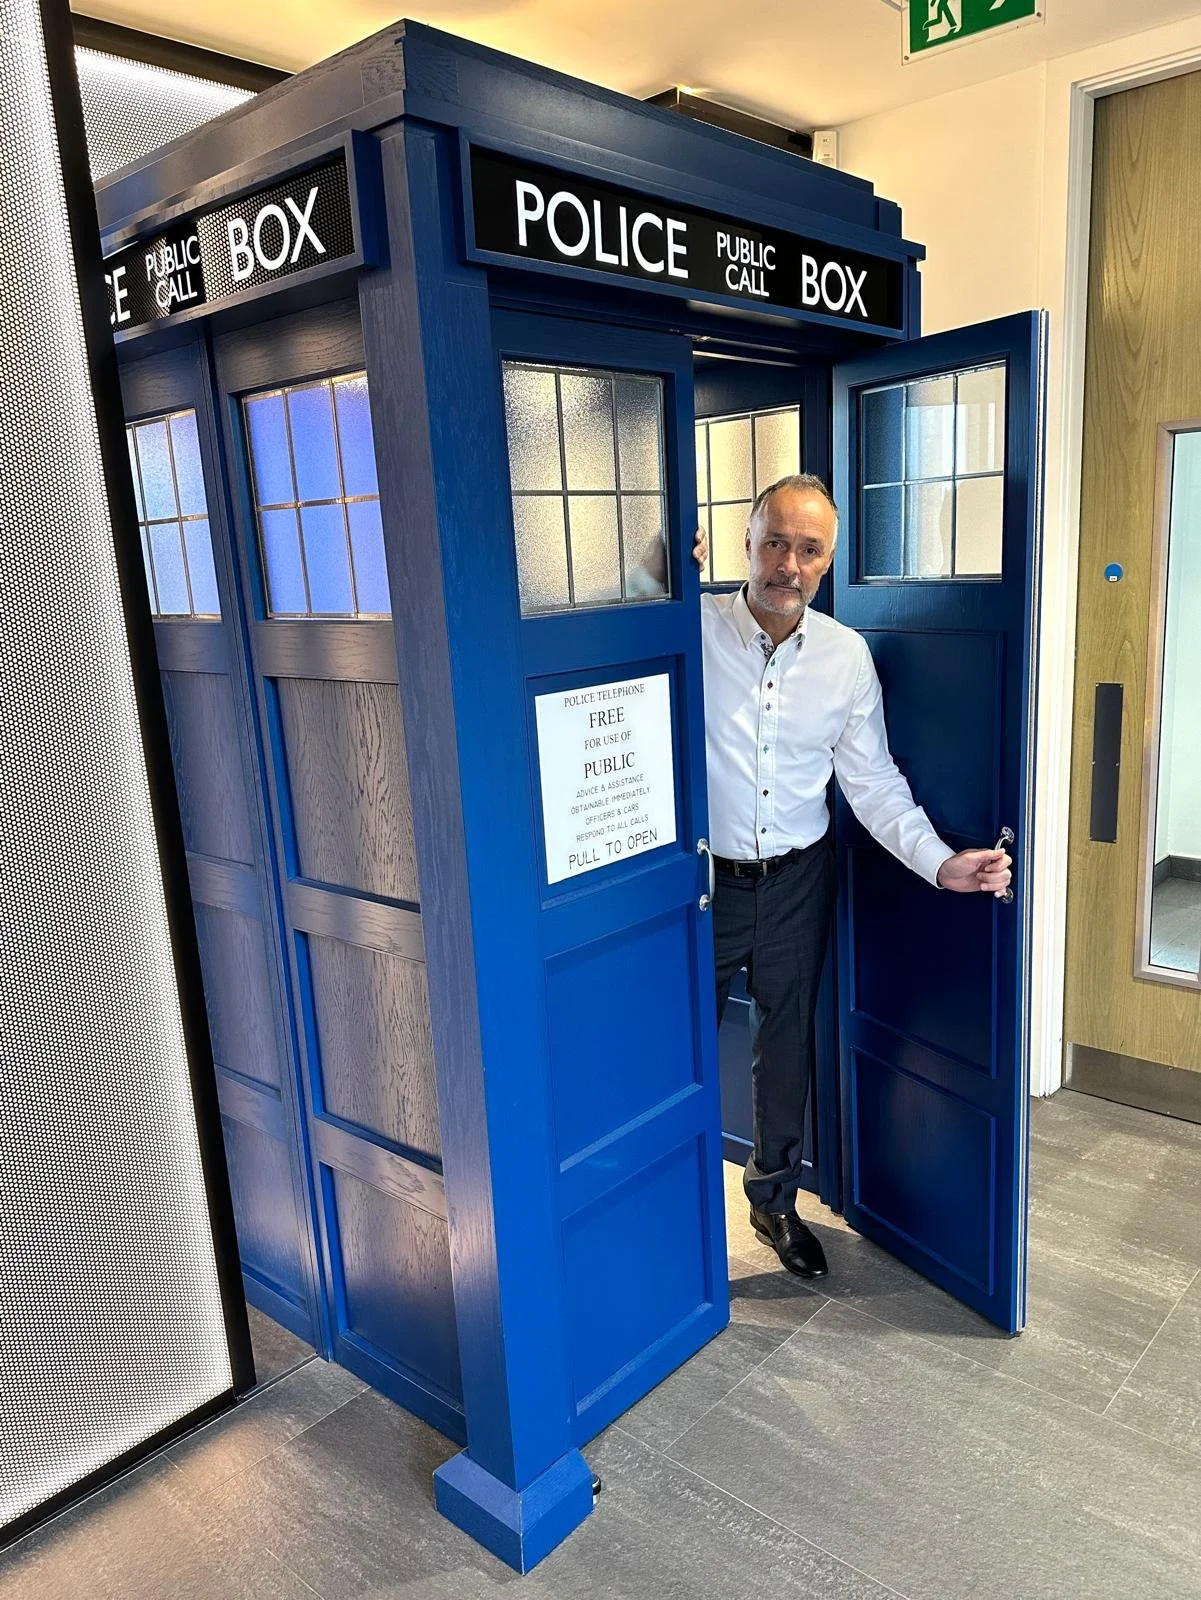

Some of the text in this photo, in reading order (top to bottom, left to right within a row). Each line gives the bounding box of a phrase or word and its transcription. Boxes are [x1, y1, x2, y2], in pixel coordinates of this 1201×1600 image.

[227, 187, 326, 282] BOX
[516, 180, 688, 278] POLICE
[146, 236, 200, 280] PUBLIC
[717, 232, 776, 271] PUBLIC
[155, 271, 197, 307] CALL
[726, 265, 769, 297] CALL
[802, 255, 868, 317] BOX
[564, 684, 645, 707] POLICE TELEPHONE
[589, 707, 624, 728] FREE
[584, 731, 632, 749] FOR USE OF
[584, 752, 635, 779] PUBLIC
[571, 787, 650, 814] OBTAINABLE IMMEDIATELY
[576, 785, 598, 798] ADVICE
[608, 774, 644, 789] ASSISTANCE
[577, 814, 648, 842] RESPOND TO ALL CALLS
[586, 810, 615, 825] OFFICERS
[624, 803, 639, 814] CARS
[569, 828, 657, 869] PULL TO OPEN
